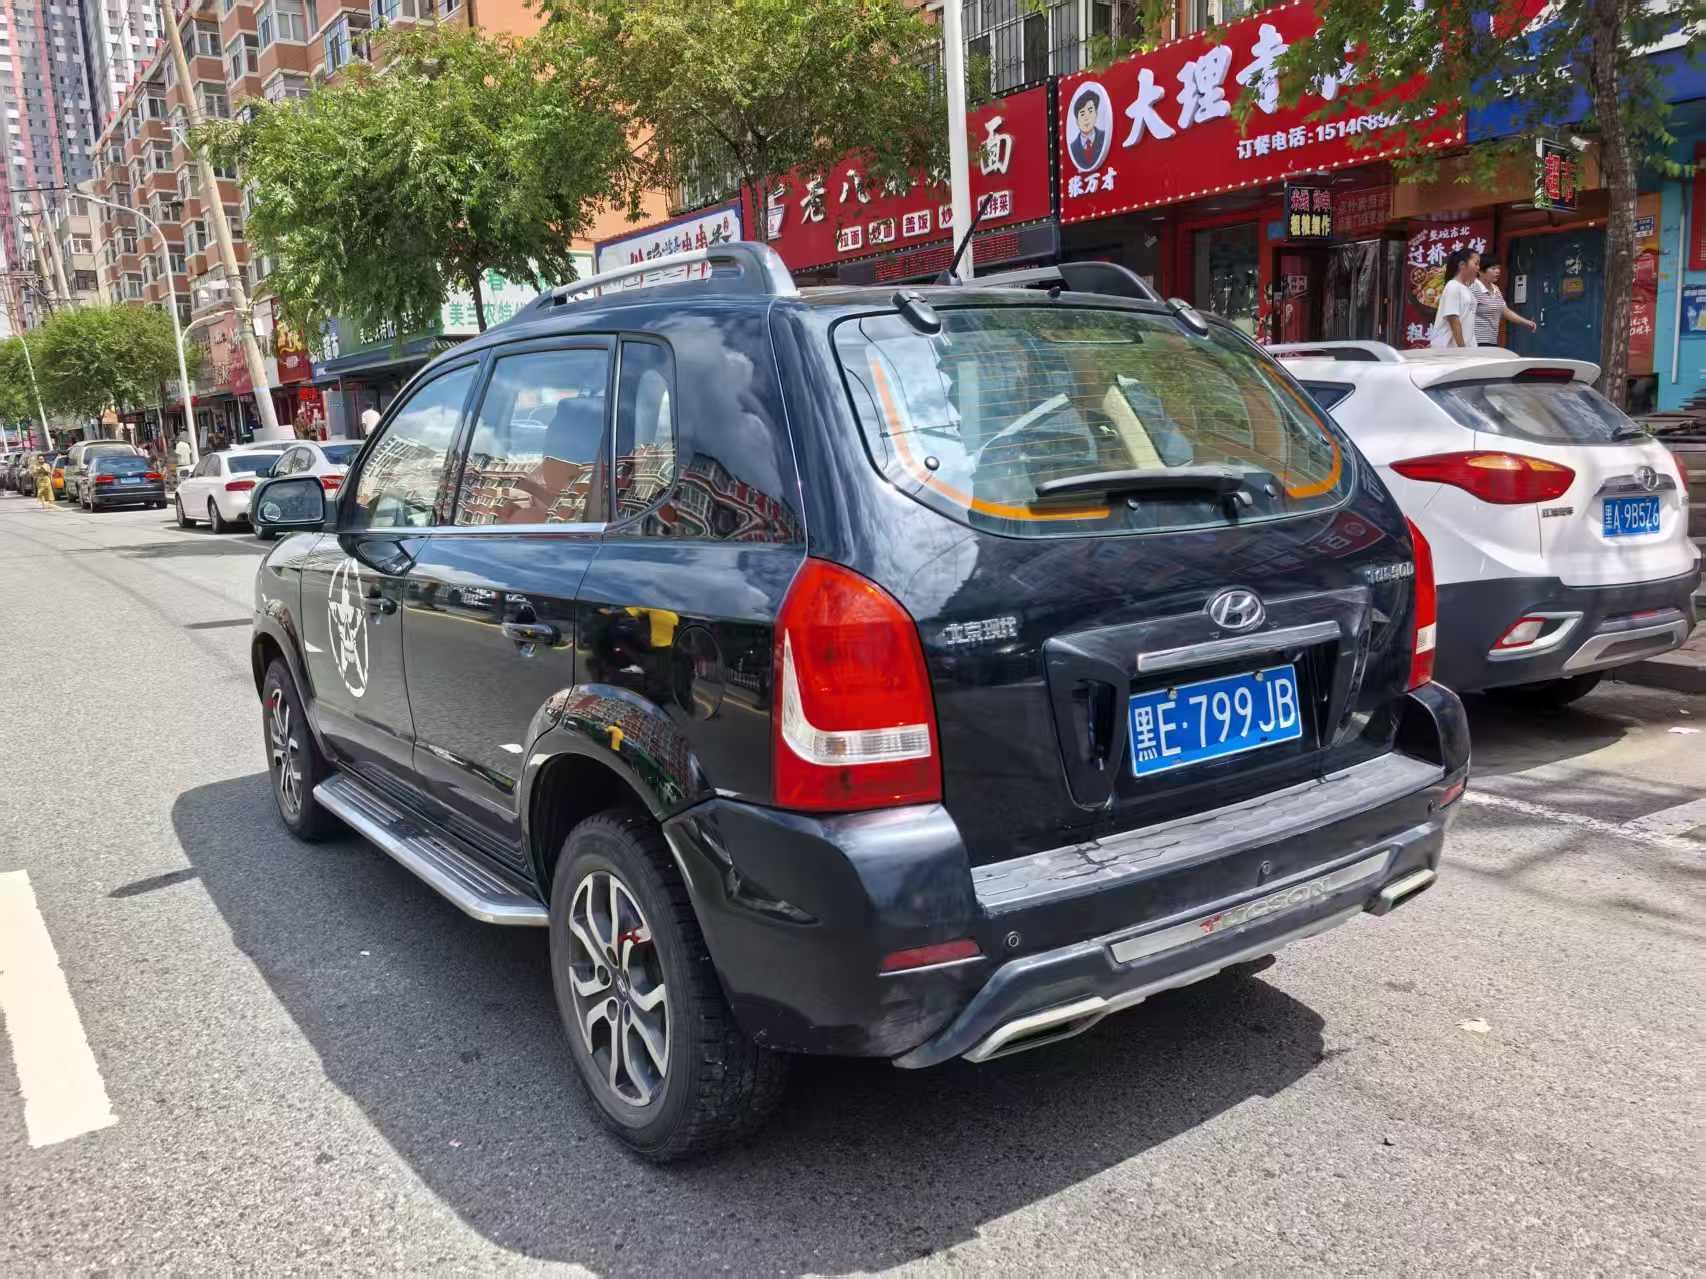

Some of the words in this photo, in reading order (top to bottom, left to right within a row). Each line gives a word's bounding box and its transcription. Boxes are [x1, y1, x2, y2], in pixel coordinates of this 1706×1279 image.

[1236, 104, 1437, 159] 订餐电话:1514685
[904, 212, 929, 234] 盖饭
[943, 616, 1017, 645] 北京现代
